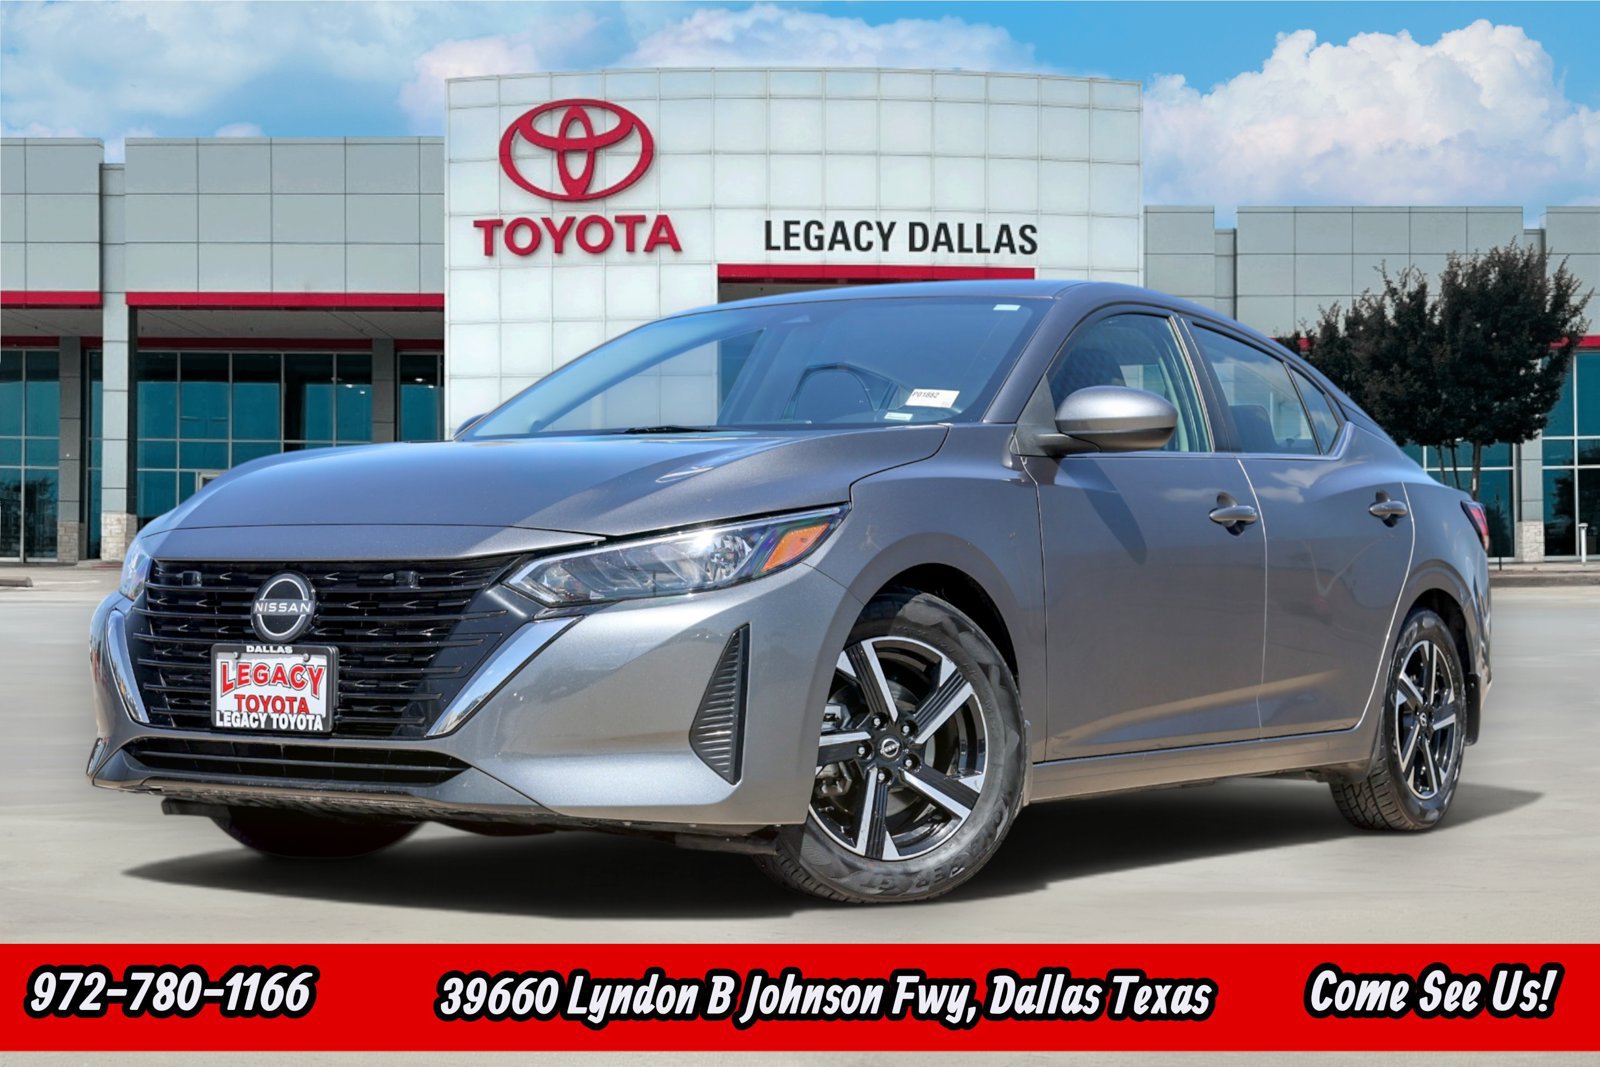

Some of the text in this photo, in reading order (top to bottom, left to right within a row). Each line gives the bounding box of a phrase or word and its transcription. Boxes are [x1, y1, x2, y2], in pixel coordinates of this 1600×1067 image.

[473, 214, 682, 257] TOYOTA
[764, 220, 1039, 255] LEGACY DALLAS
[254, 602, 311, 613] NISSAN
[246, 645, 293, 654] DALLAS
[221, 662, 325, 699] LEGACY
[234, 694, 310, 714] TOYOTA
[216, 711, 324, 731] LEGACY TOYOTA
